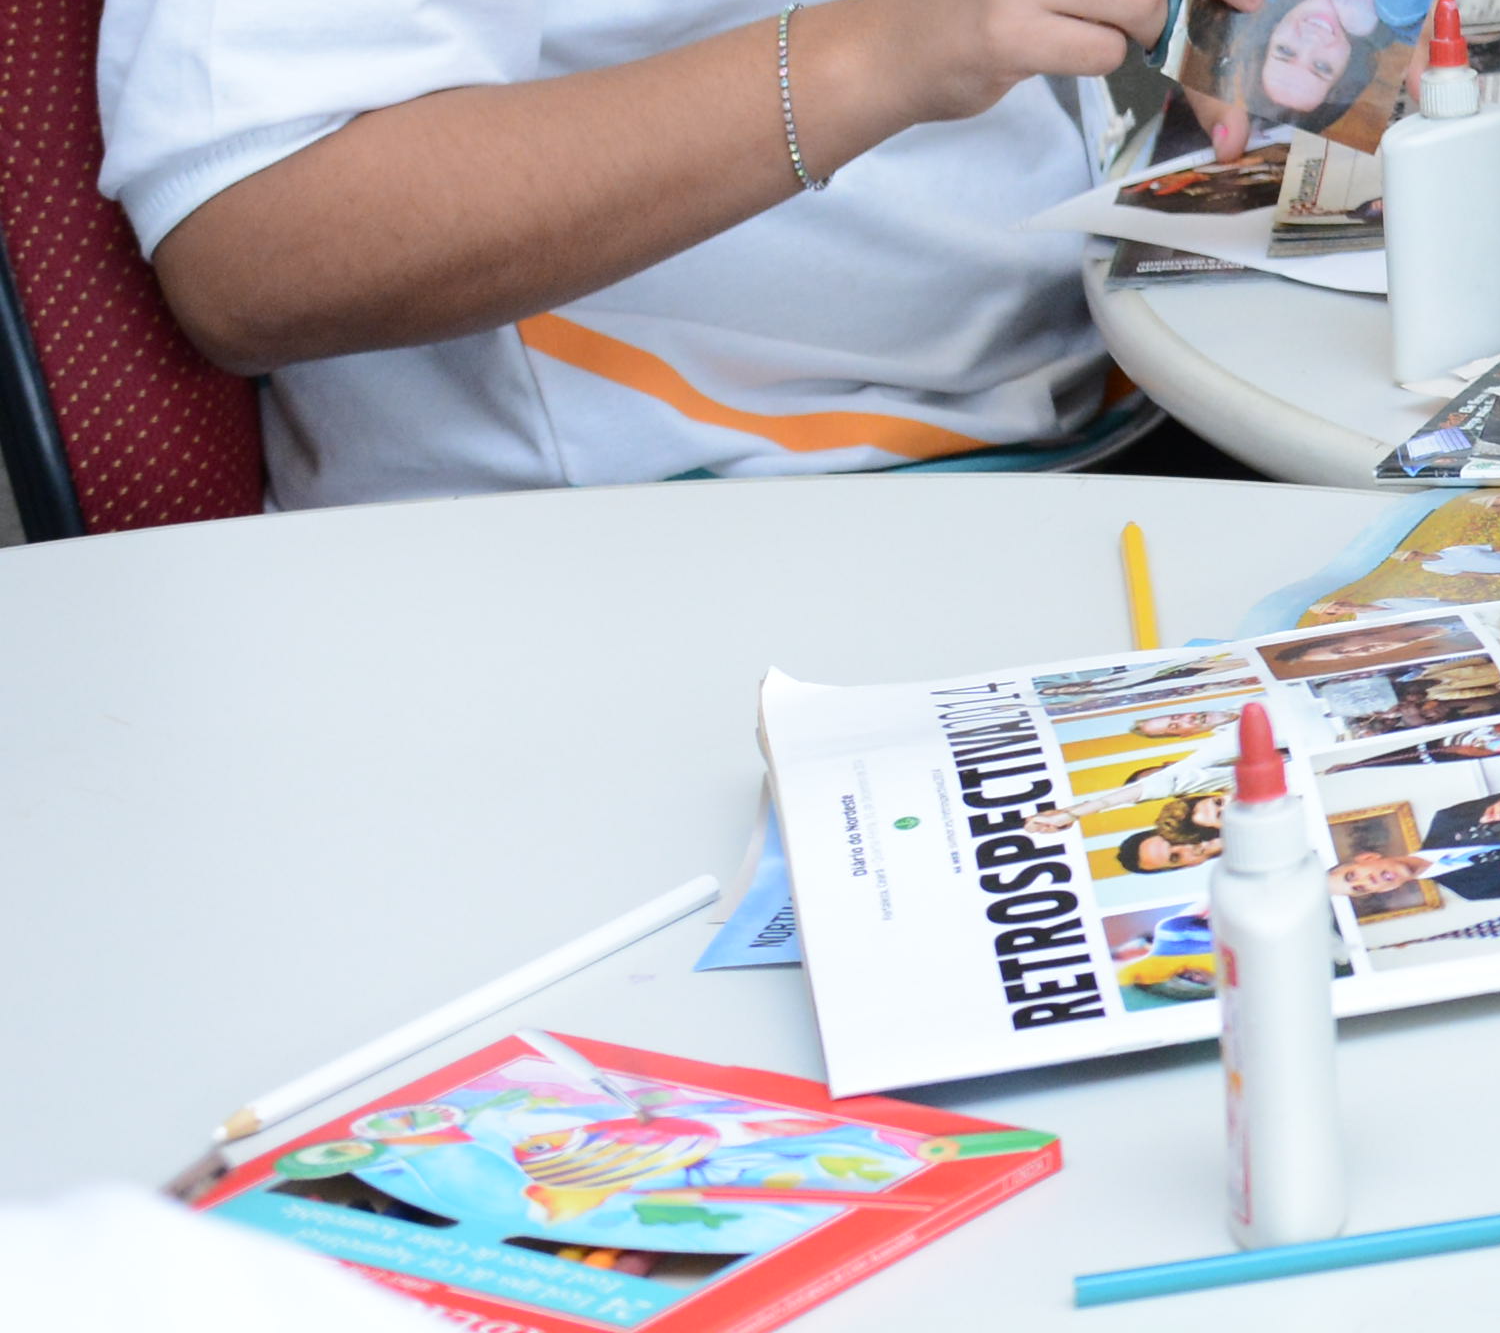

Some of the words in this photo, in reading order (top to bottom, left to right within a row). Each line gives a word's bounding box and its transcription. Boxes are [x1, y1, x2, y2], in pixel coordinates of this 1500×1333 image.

[841, 794, 859, 832] Nordeste
[847, 833, 862, 845] do
[852, 846, 867, 877] Diário
